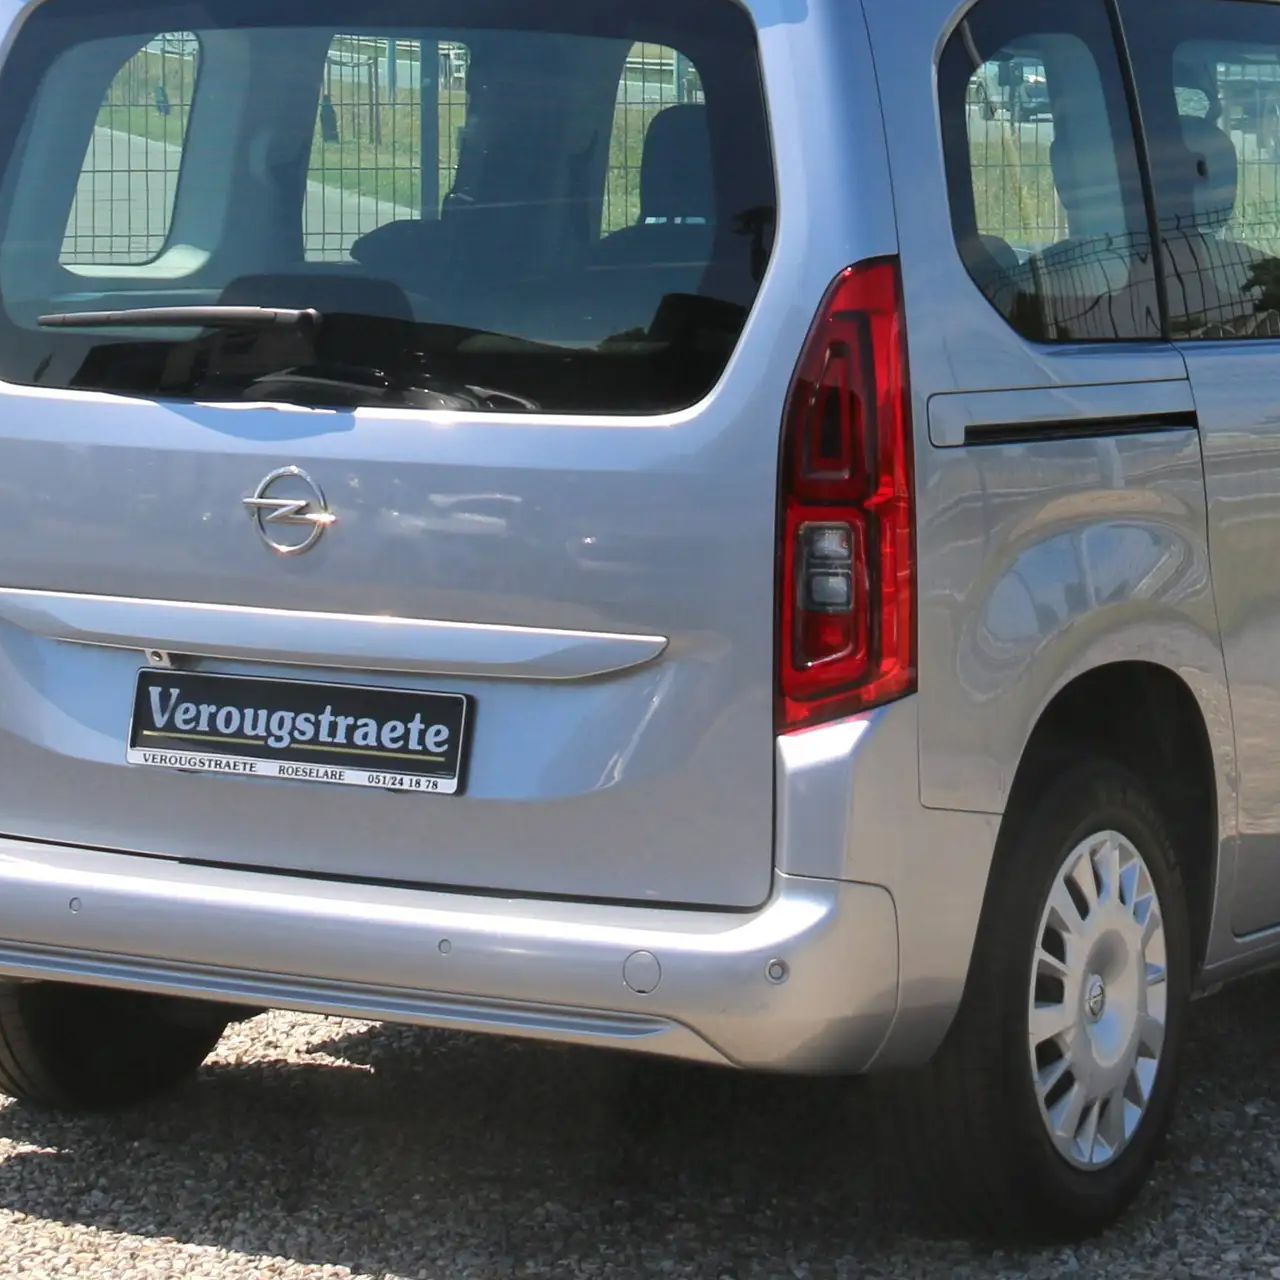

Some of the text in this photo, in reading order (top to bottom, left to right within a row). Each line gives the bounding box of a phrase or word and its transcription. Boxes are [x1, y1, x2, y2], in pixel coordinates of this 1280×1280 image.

[147, 686, 450, 753] Verougstraete
[142, 753, 438, 790] VEROUGSTRAETE ROESELARE 051/24 18 78
